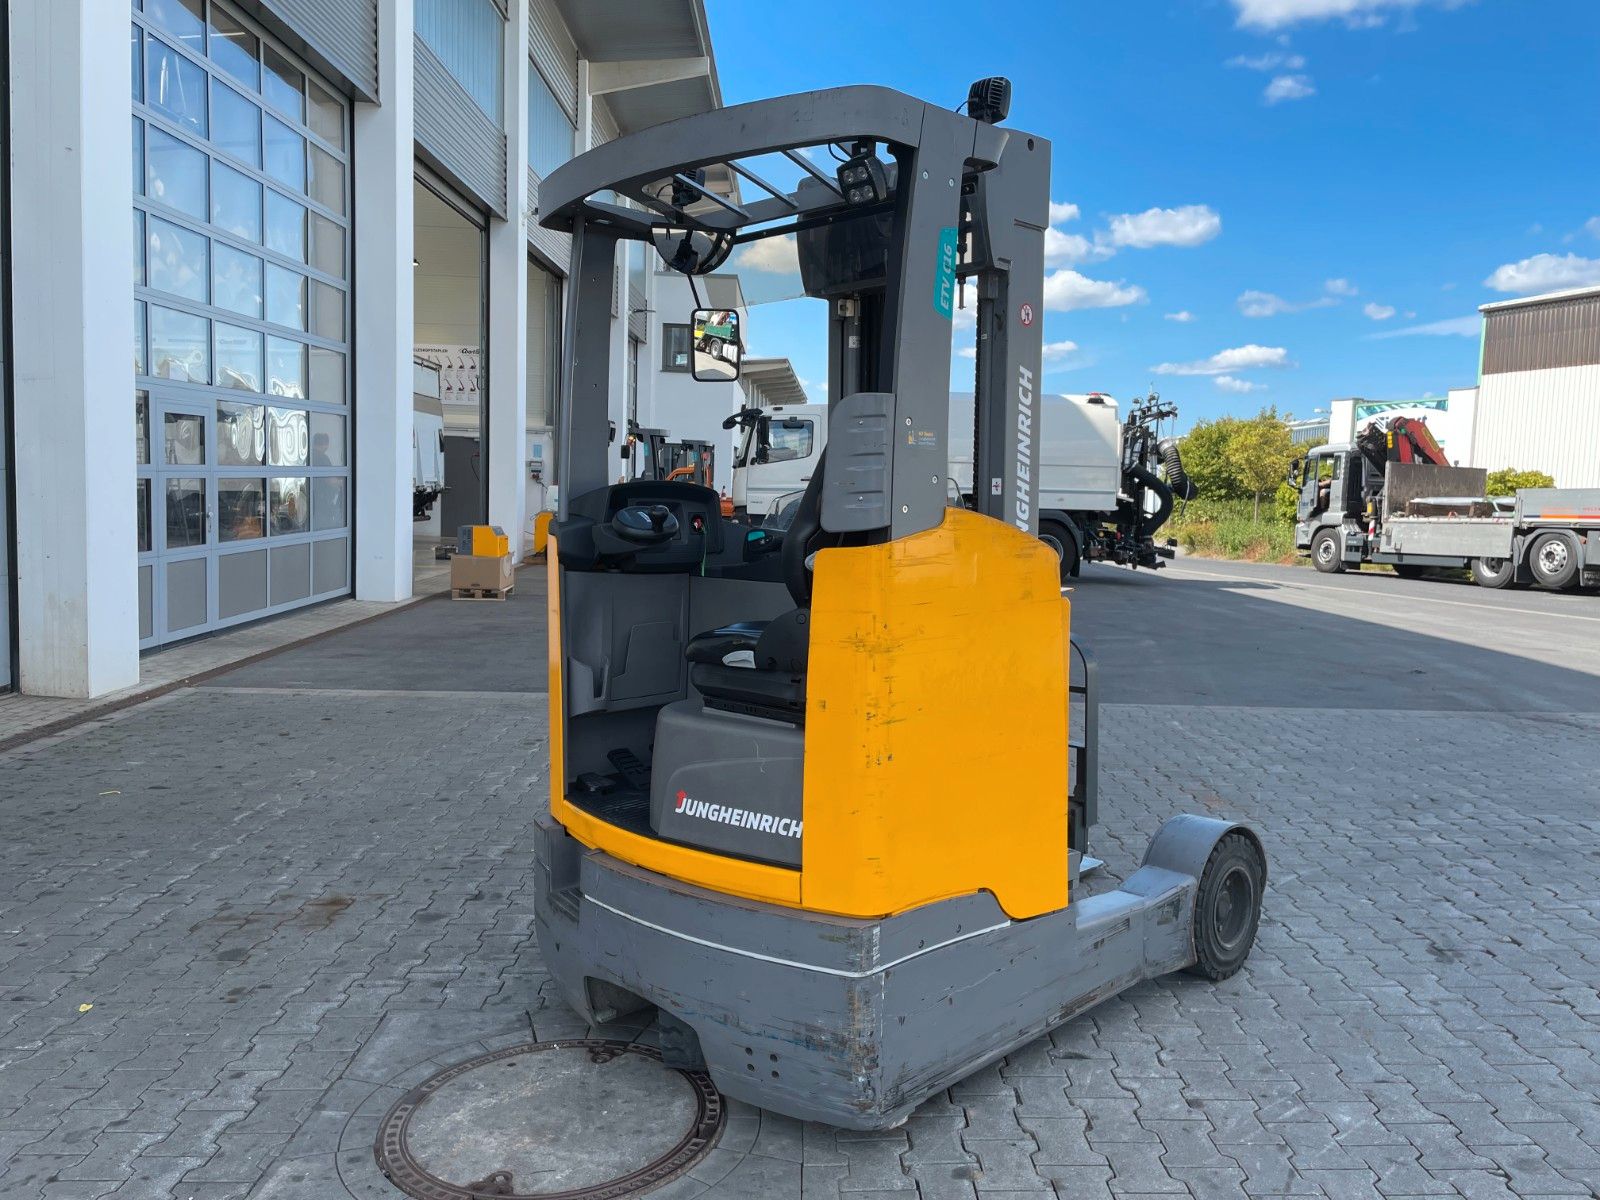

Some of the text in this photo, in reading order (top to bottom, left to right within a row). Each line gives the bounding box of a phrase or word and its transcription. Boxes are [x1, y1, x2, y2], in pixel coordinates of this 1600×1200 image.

[940, 242, 953, 310] ETV C16
[675, 797, 803, 839] JUNGHEINRICH
